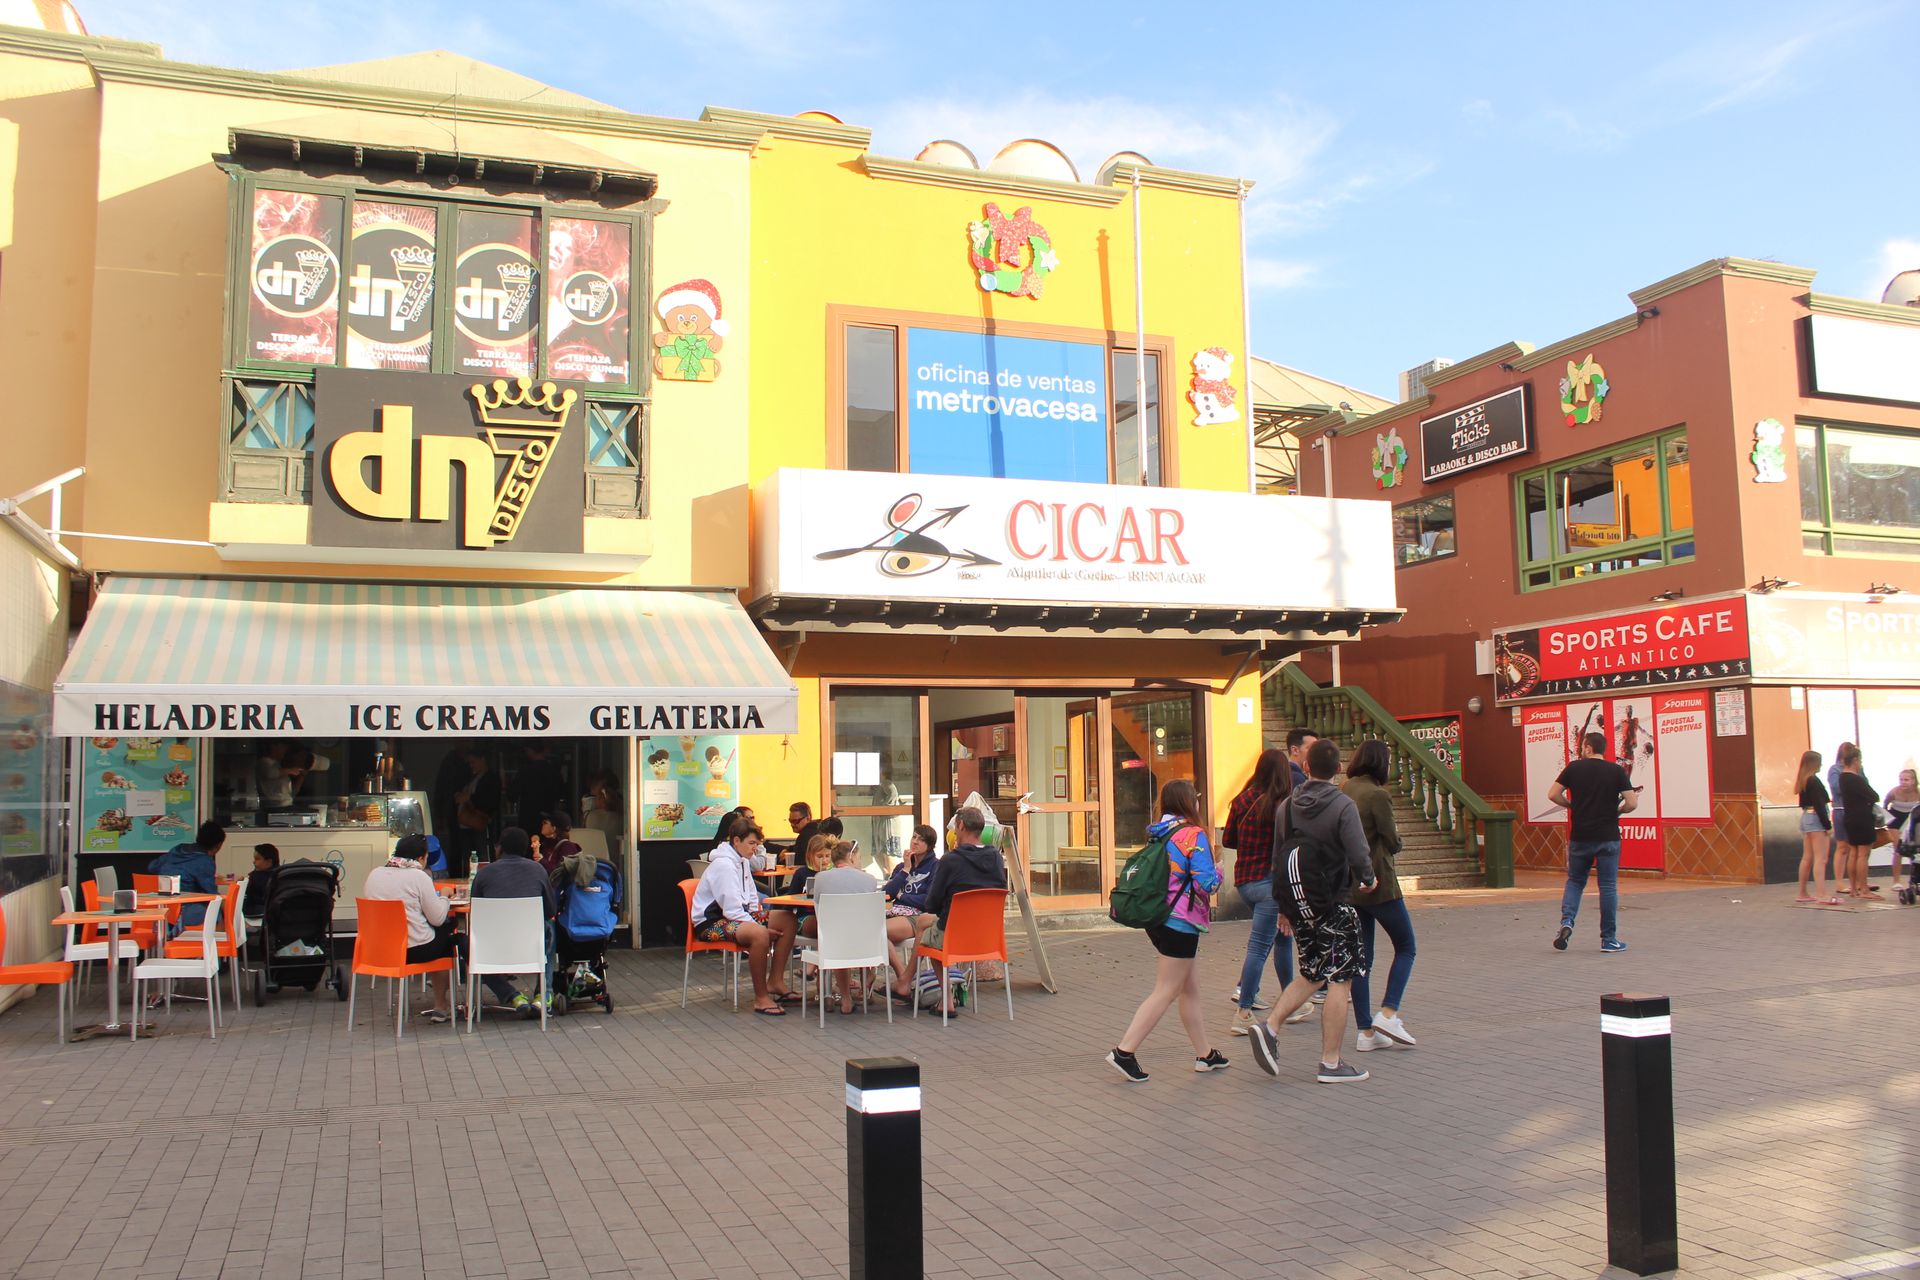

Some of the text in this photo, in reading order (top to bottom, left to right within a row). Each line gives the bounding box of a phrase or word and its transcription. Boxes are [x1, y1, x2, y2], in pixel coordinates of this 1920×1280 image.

[400, 272, 427, 316] DISCO
[504, 283, 526, 319] DISCO
[464, 358, 493, 369] DISCO
[477, 350, 521, 361] TERRAZA
[569, 354, 611, 364] TERRAZA
[555, 359, 624, 374] DISCO LOUNGE
[917, 362, 1096, 394] oficina de ventas
[916, 389, 1098, 423] metrovacesa
[1450, 423, 1490, 450] Flicks
[1430, 455, 1466, 475] KARAOKE
[1467, 454, 1474, 464] &
[1475, 446, 1500, 462] DISCO
[1501, 440, 1518, 454] BAR
[493, 439, 548, 533] DISCO
[1006, 499, 1190, 565] CICAR
[1550, 609, 1734, 655] SPORTS CAFE
[1579, 645, 1695, 672] ATLANTICO
[1660, 698, 1702, 711] SPORTIUM
[94, 704, 765, 731] HELADERIA ICE CREAMS GELATERIA
[1528, 710, 1561, 722] SPORTIUM
[1661, 716, 1695, 727] APUESTAS
[1527, 733, 1562, 744] DEPORTIVAS
[1528, 726, 1556, 737] APUESTAS
[1660, 723, 1702, 735] DEPORTIVAS
[1618, 825, 1657, 840] RTIUM
